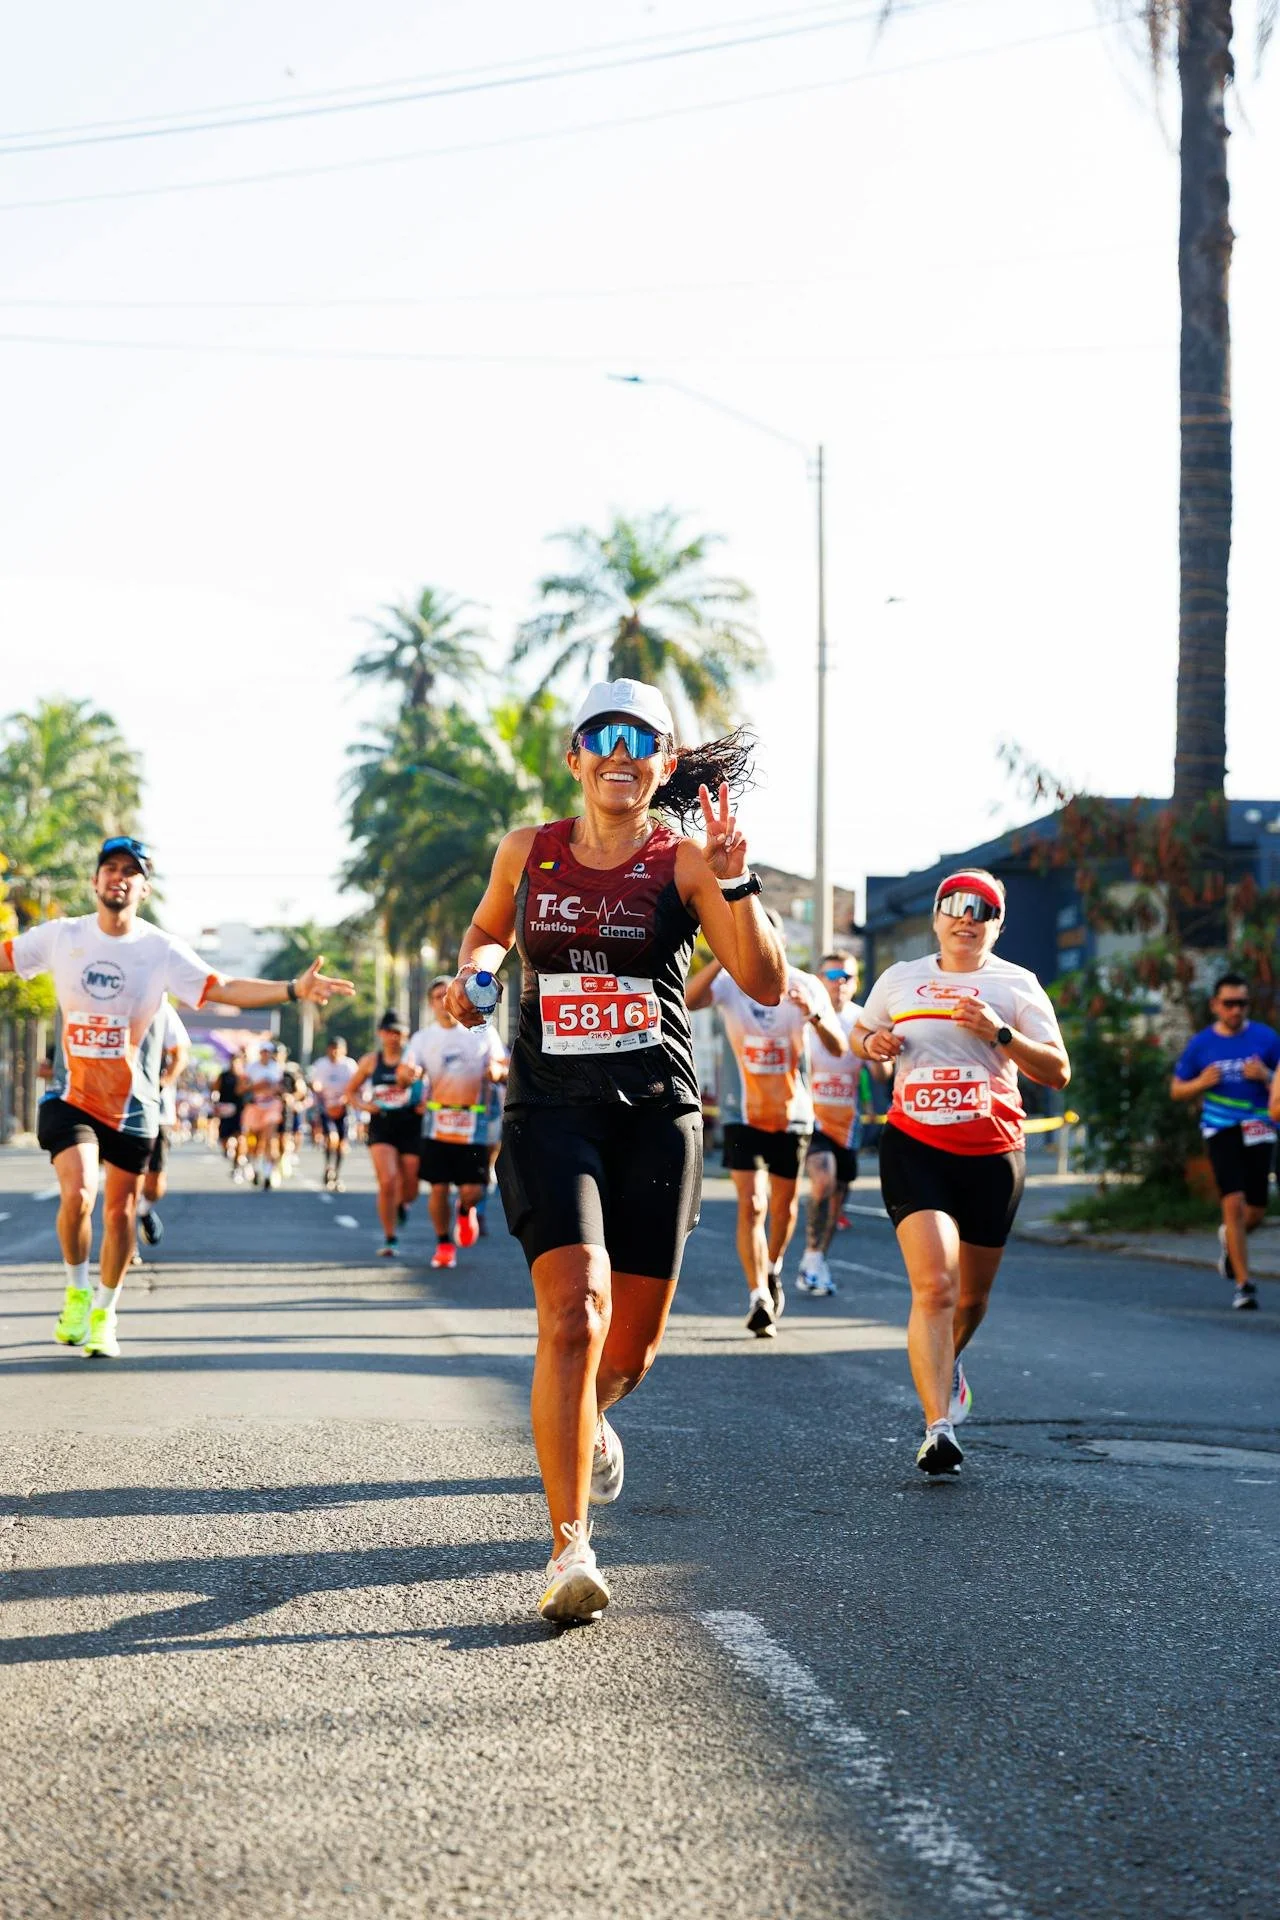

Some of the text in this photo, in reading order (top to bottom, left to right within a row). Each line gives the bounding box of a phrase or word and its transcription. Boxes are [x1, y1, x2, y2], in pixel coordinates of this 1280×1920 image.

[530, 921, 576, 933] Triatlón
[600, 926, 645, 938] Ciencia
[568, 948, 609, 974] PAO
[558, 1002, 645, 1031] 5816
[75, 1028, 120, 1045] 1345
[915, 1087, 978, 1109] 6294
